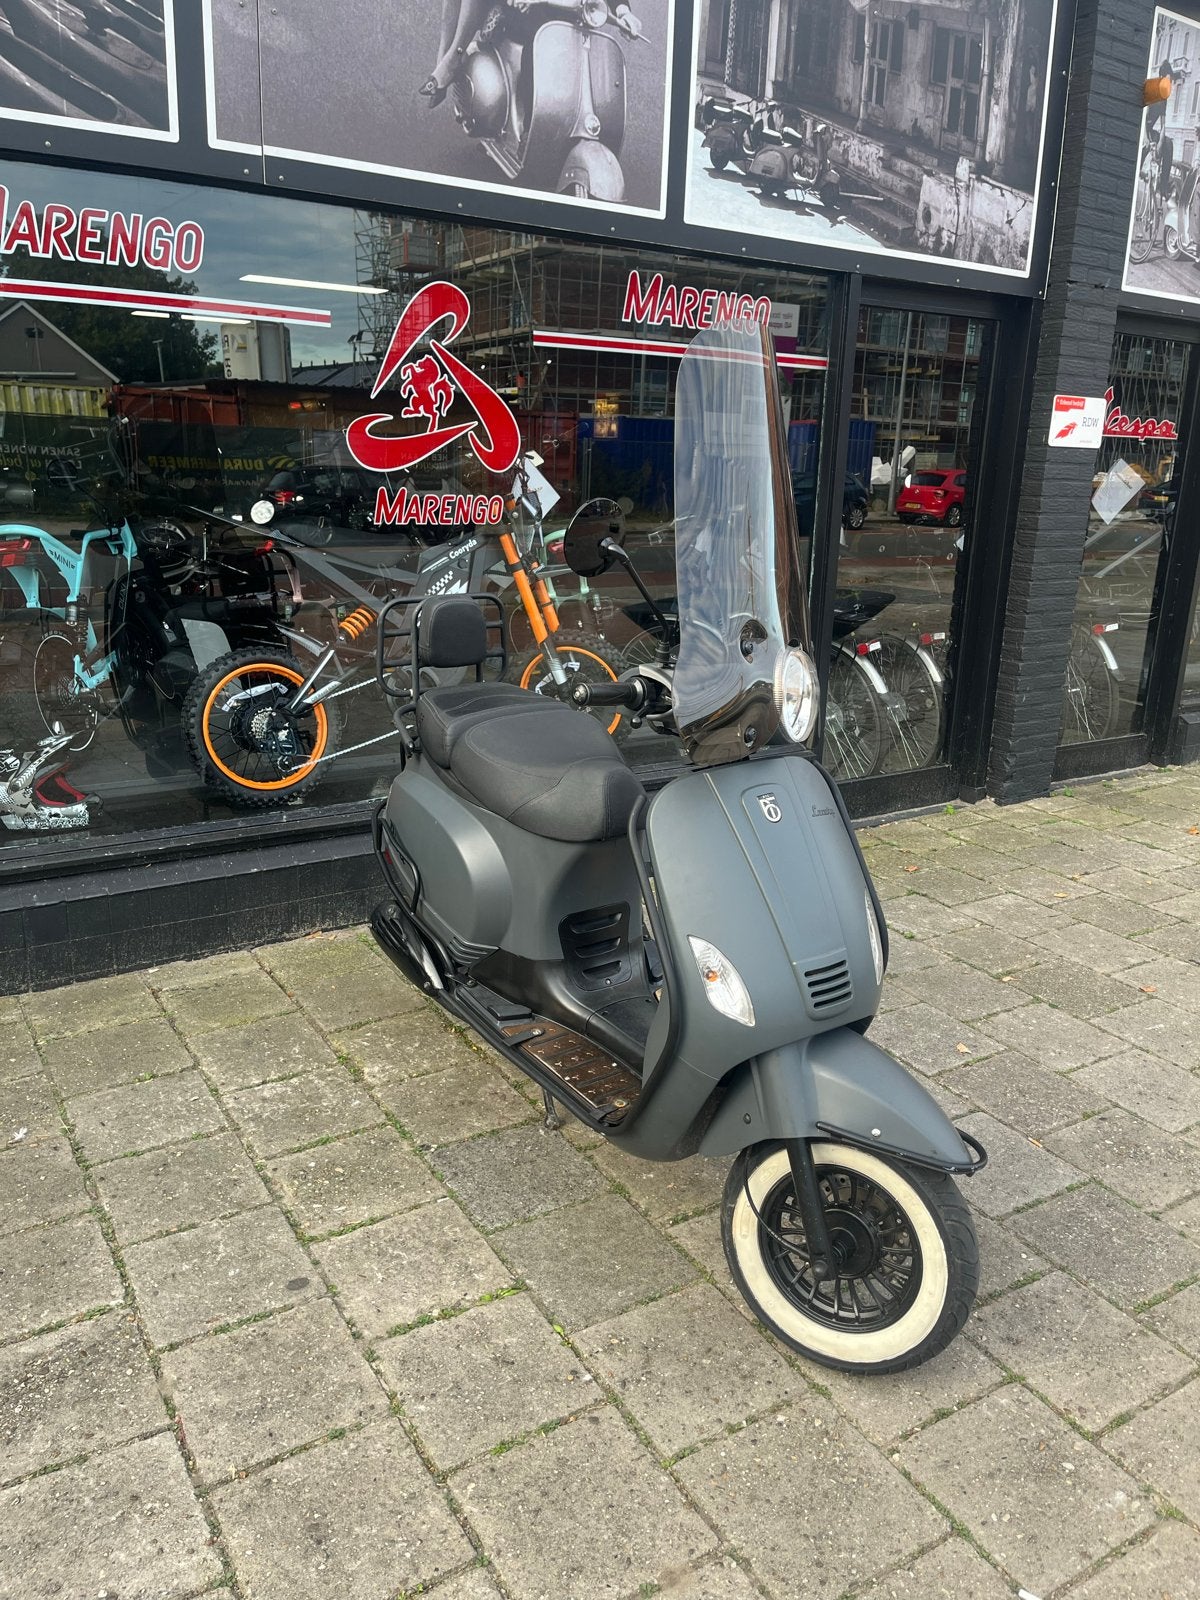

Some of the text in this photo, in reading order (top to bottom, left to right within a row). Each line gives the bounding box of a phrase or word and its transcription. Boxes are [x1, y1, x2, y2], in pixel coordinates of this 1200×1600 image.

[0, 184, 205, 274] ARENGO
[622, 270, 771, 336] MARENGO
[1081, 416, 1100, 428] RDW
[1103, 386, 1178, 441] Vespa
[374, 486, 504, 526] MARENGO
[53, 550, 72, 570] MINI
[448, 538, 478, 560] Cooryda
